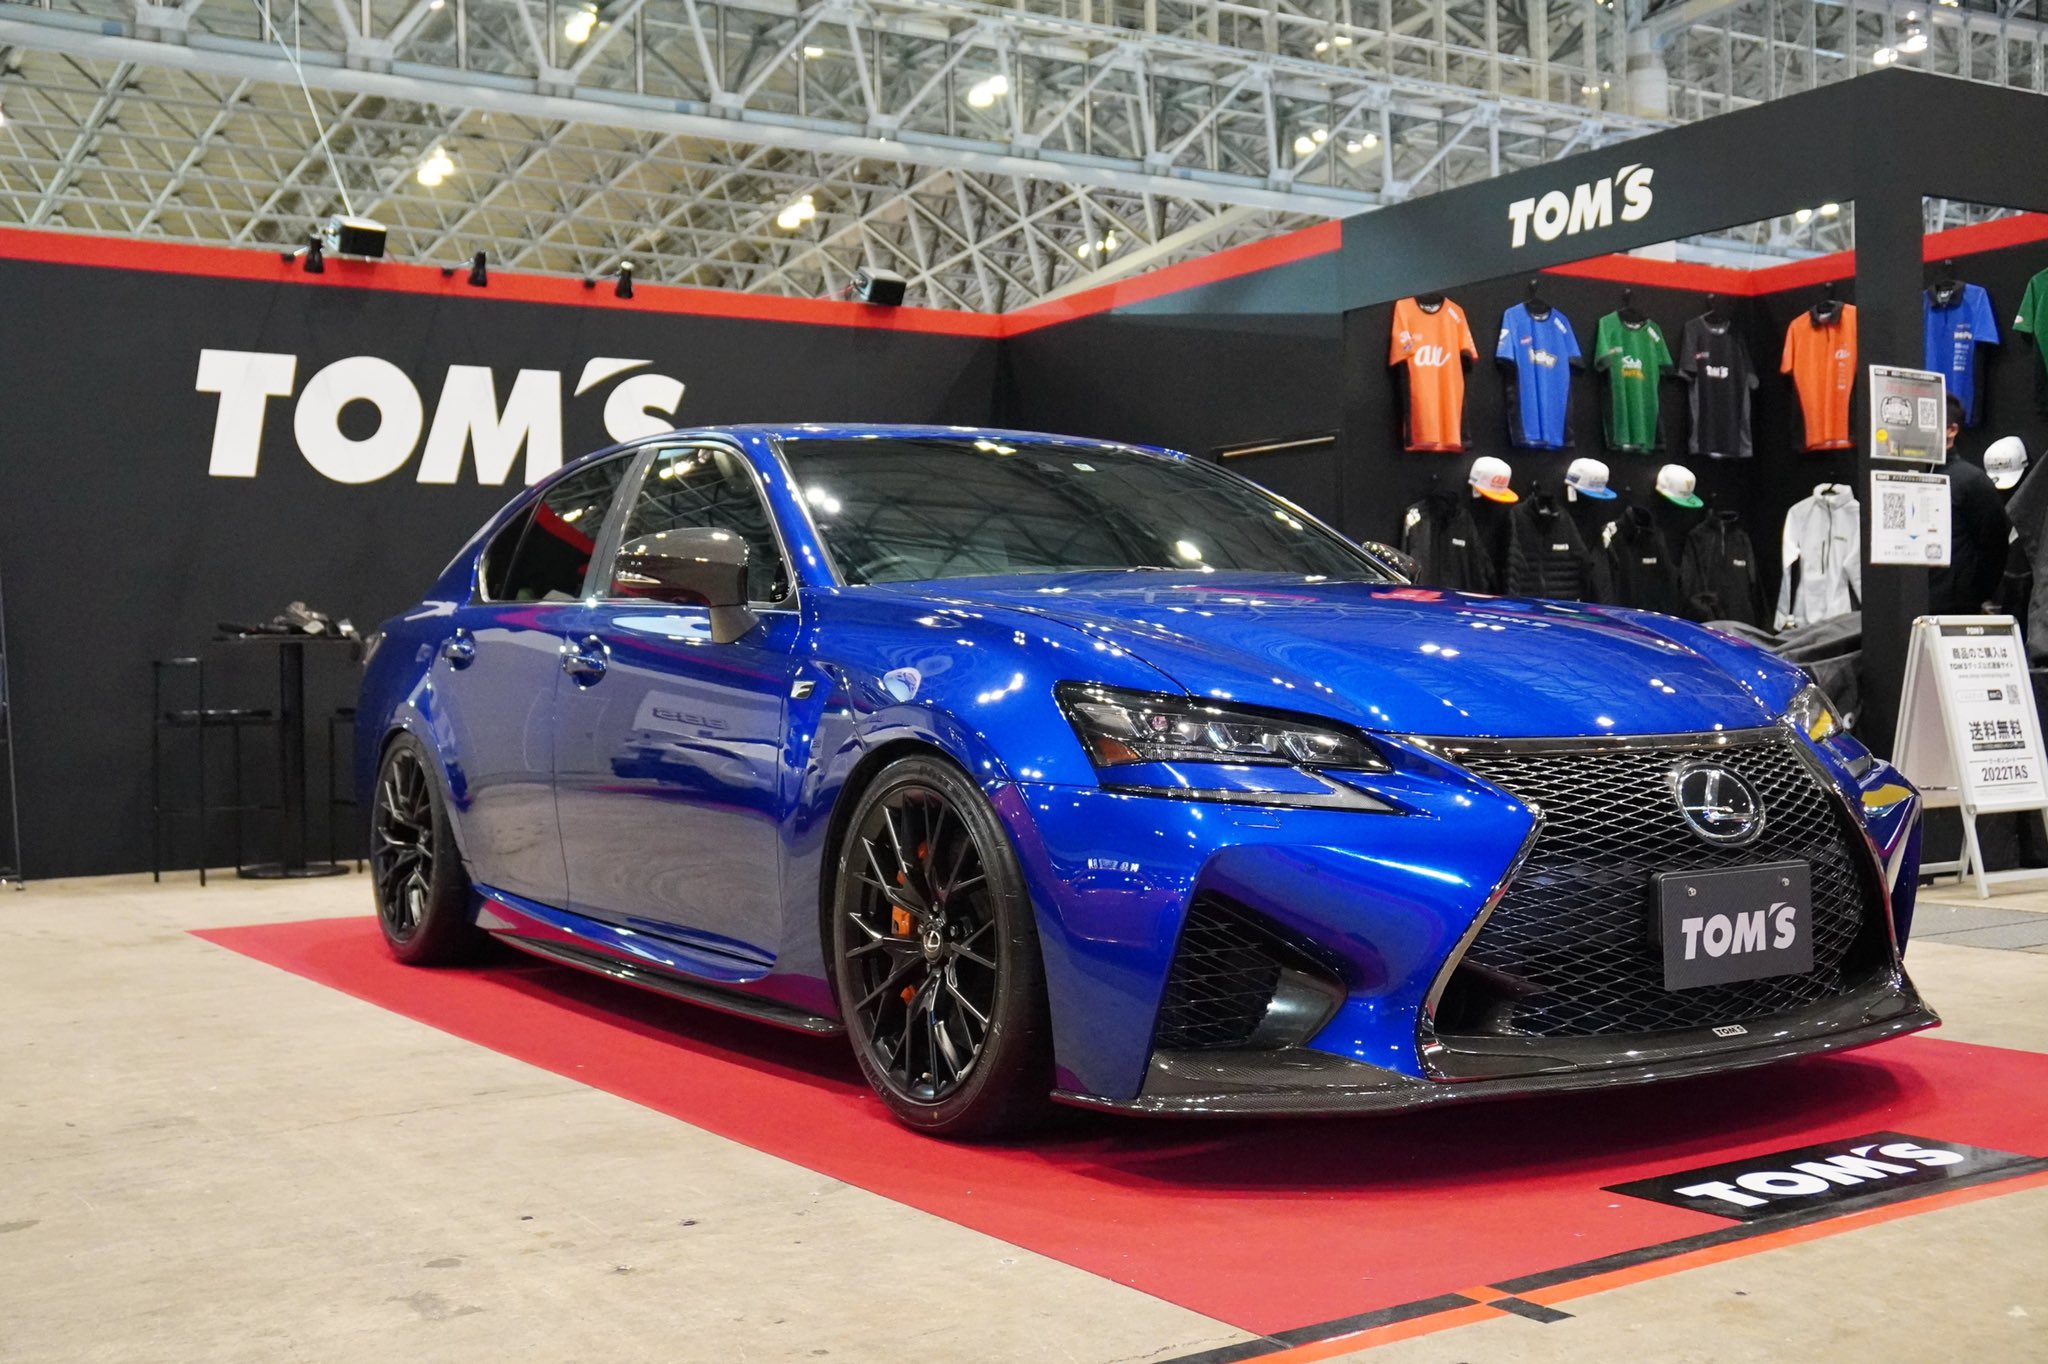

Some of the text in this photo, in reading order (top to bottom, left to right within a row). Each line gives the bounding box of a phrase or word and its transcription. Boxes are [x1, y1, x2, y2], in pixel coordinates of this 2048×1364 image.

[1508, 163, 1654, 248] TOM'S
[1414, 344, 1451, 368] au
[195, 348, 685, 486] TOM'S
[1952, 647, 2008, 659] 商品のご購入は
[1969, 719, 2023, 741] 送料無料
[1982, 765, 2028, 781] 2022TAS
[1681, 901, 1796, 961] TOM'S
[1716, 1025, 1746, 1036] TOM'S
[1672, 1142, 1965, 1208] TOM'S
